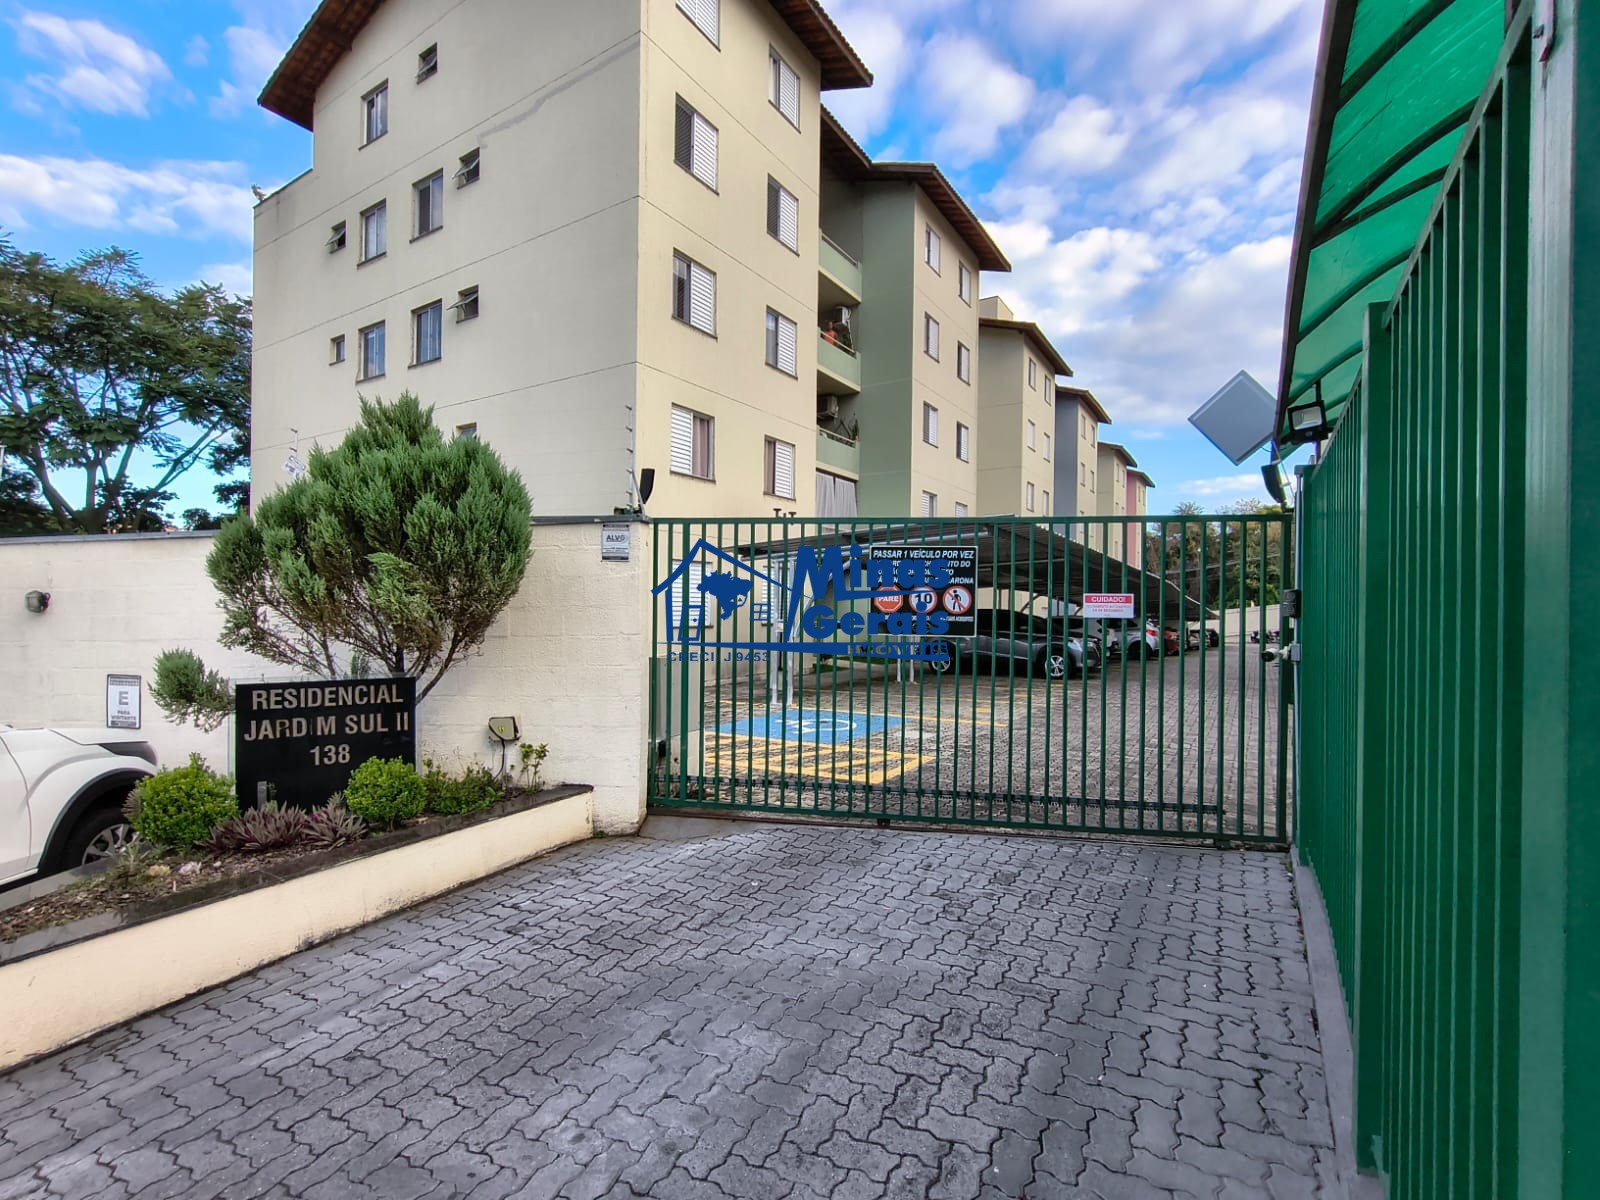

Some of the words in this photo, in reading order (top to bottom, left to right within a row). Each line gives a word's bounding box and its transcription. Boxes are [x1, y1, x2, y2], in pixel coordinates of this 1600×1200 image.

[873, 550, 901, 558] PASSAR
[904, 550, 907, 558] 1
[909, 548, 941, 559] VEÍCULO
[942, 550, 958, 559] POR
[960, 550, 974, 559] VEZ
[914, 593, 933, 604] 10
[118, 690, 129, 706] E
[252, 684, 404, 711] RESIDENCIAL
[243, 716, 337, 742] JARDM
[344, 712, 389, 735] SUL
[309, 743, 351, 766] 138
